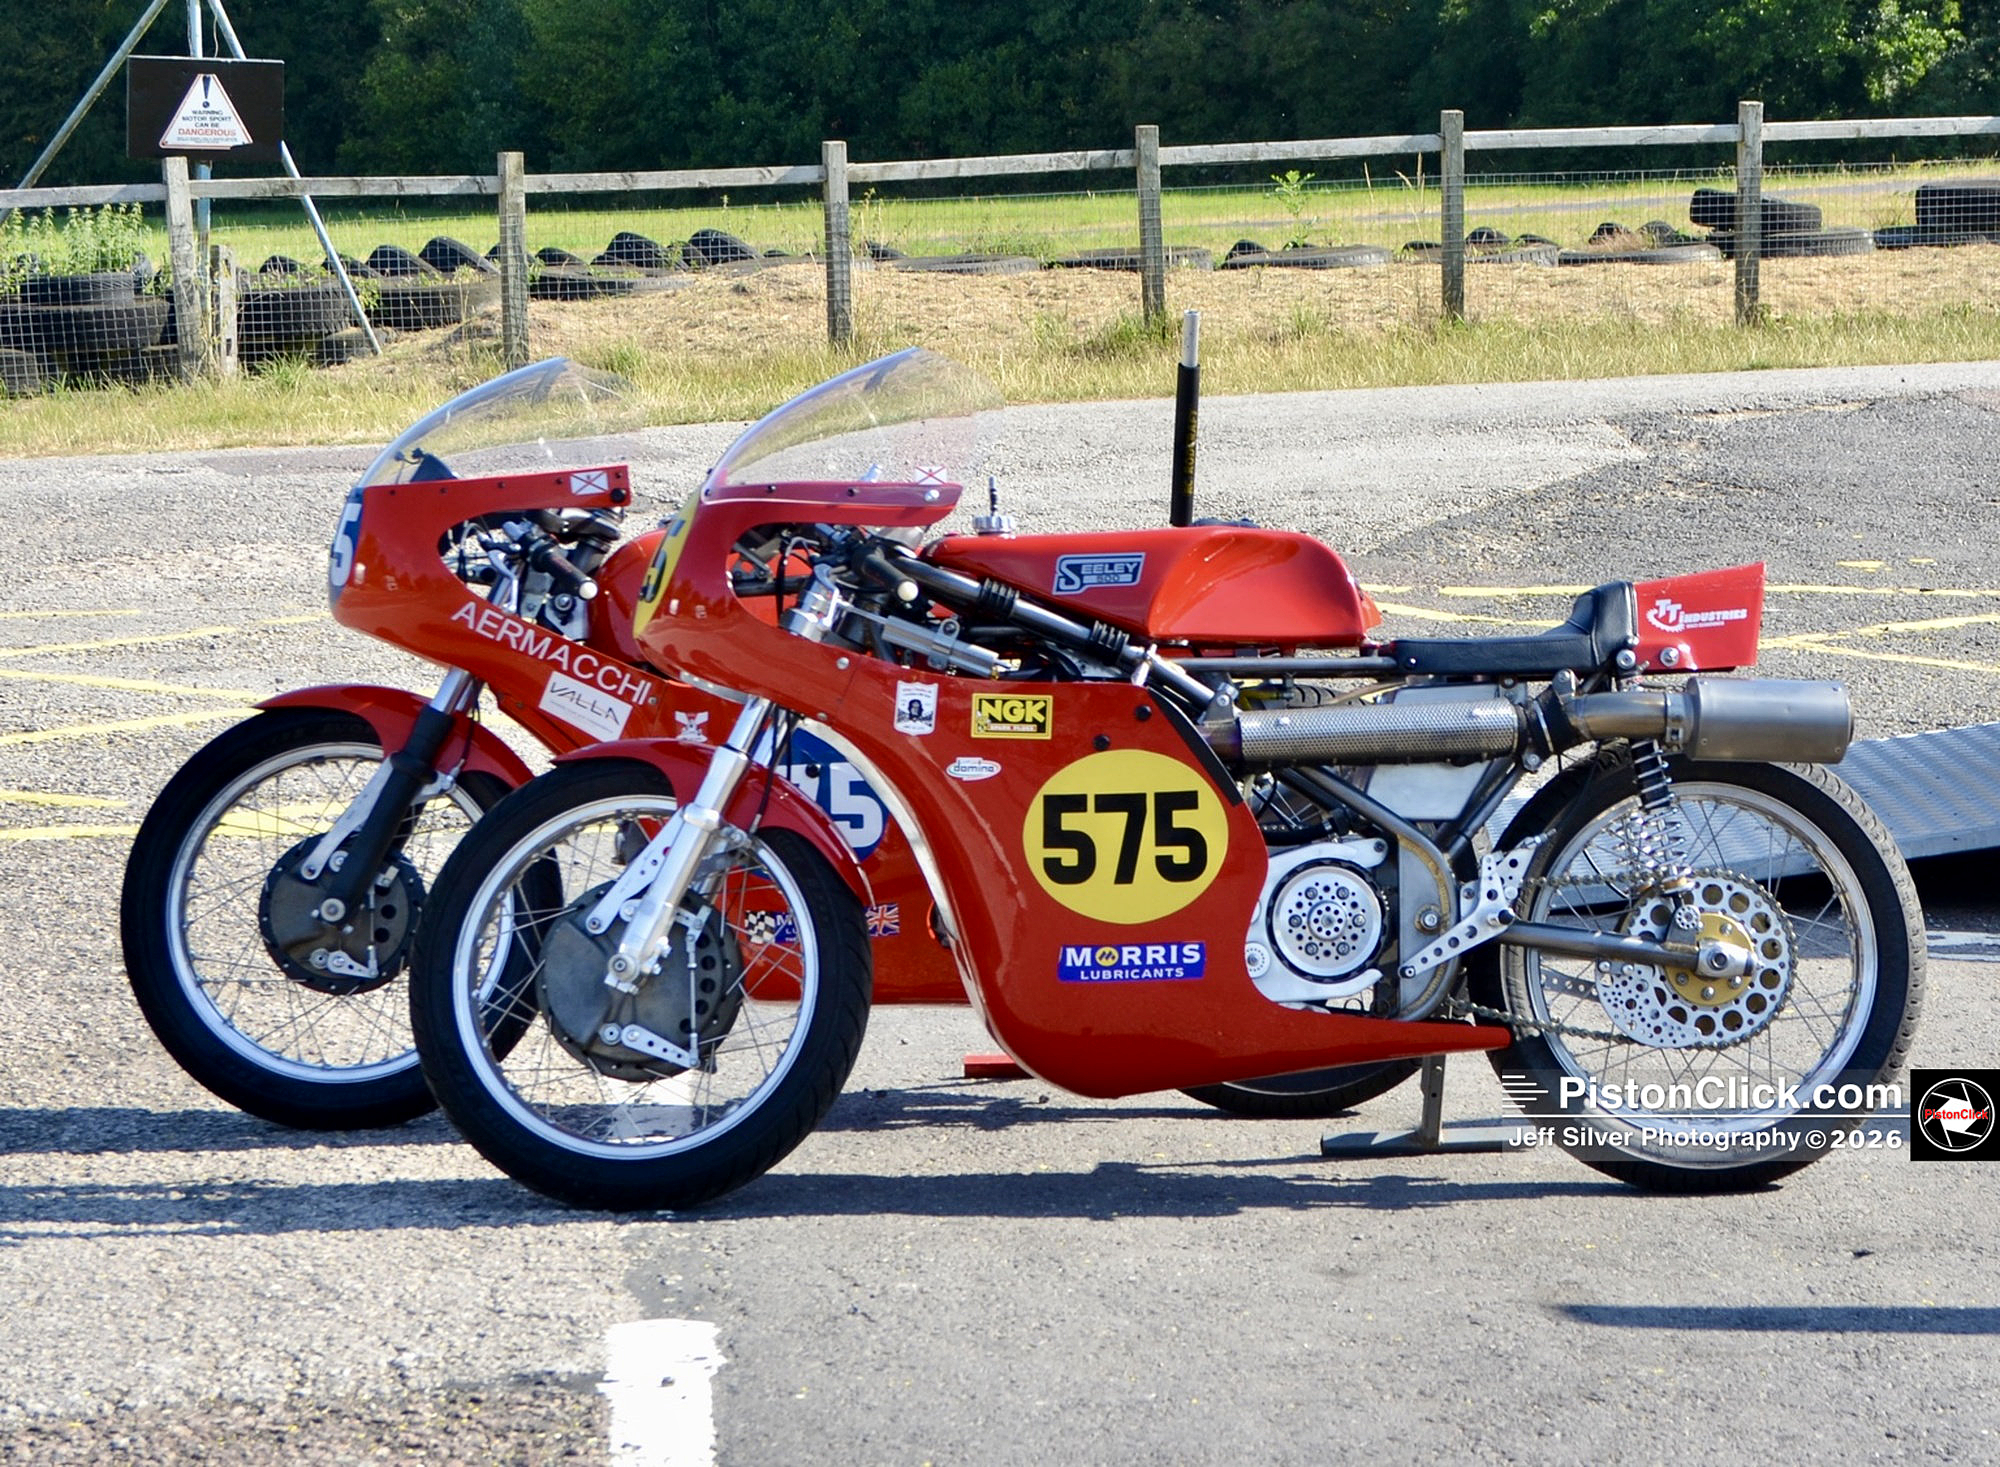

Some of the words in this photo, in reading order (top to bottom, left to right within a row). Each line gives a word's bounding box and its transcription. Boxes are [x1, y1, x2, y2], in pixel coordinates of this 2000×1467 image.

[178, 128, 236, 136] DANGEROUS
[1058, 558, 1143, 590] SEELEY
[451, 601, 652, 705] AERMACCHI
[981, 699, 1046, 723] NGK
[1043, 790, 1208, 885] 575
[1065, 944, 1201, 967] MORRIS
[1080, 967, 1185, 980] LUBRICANTS
